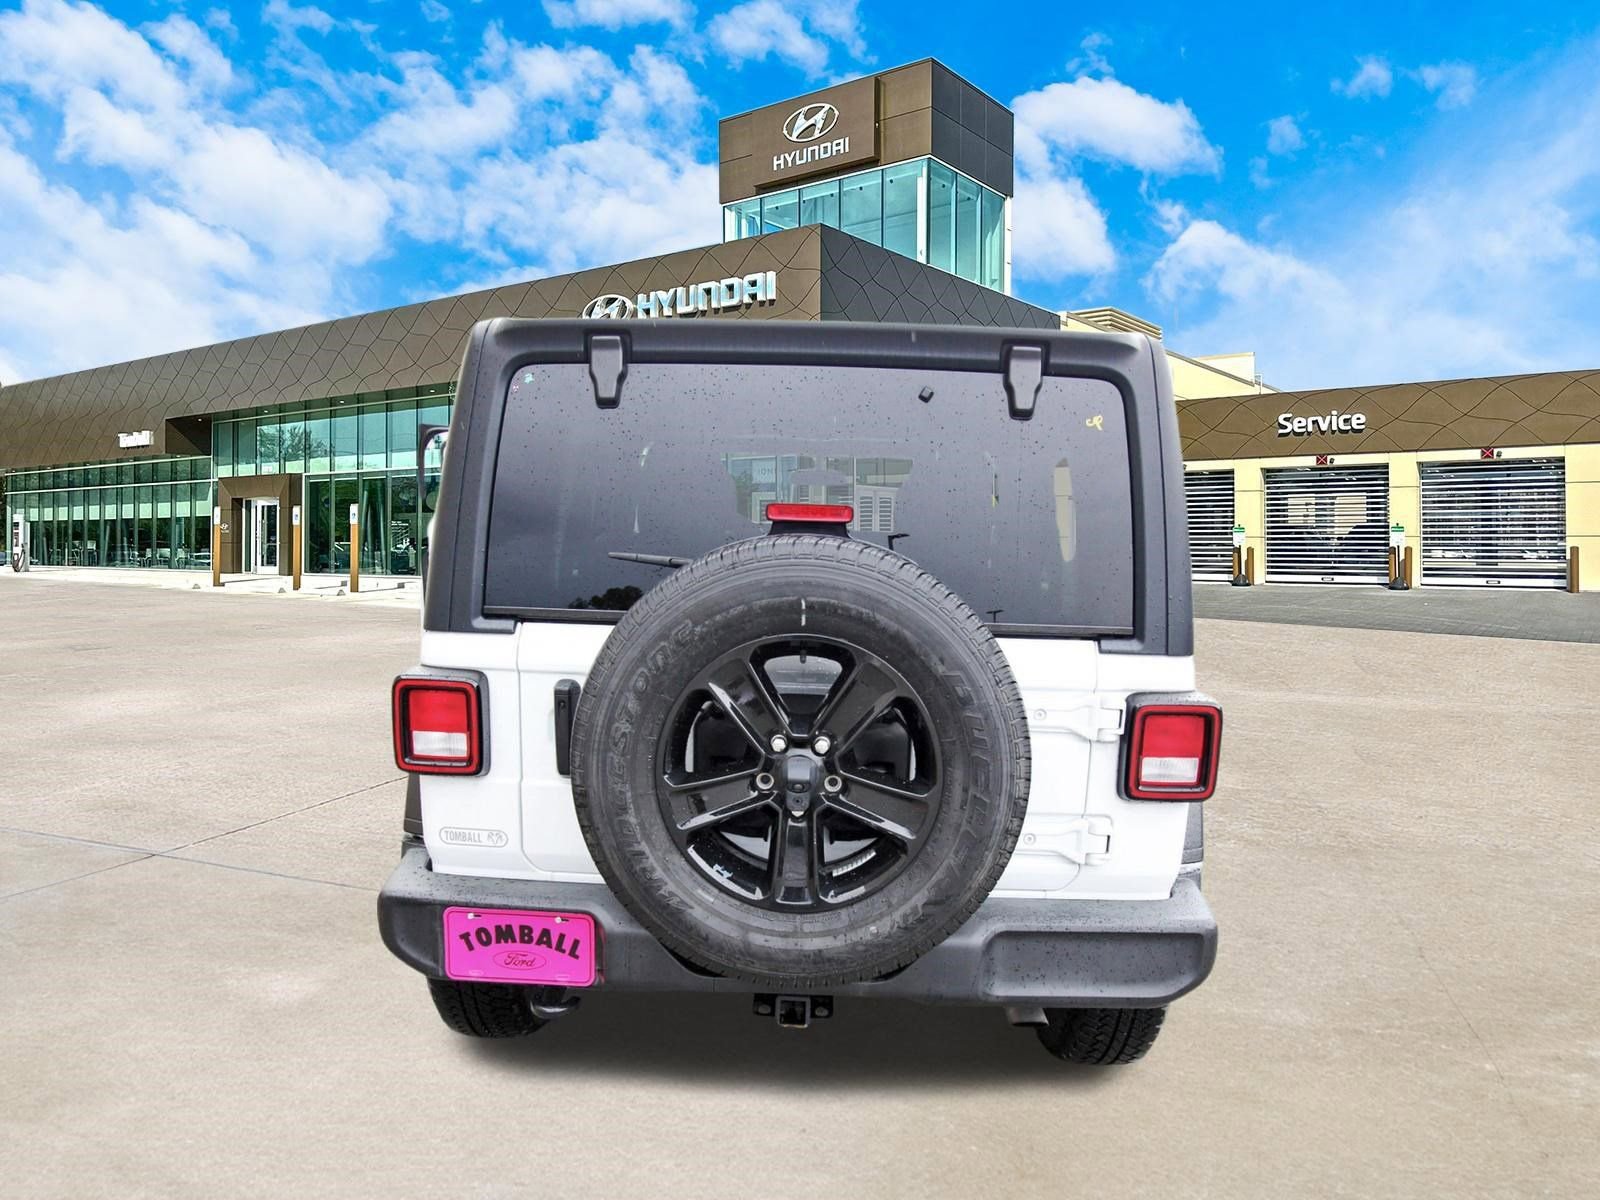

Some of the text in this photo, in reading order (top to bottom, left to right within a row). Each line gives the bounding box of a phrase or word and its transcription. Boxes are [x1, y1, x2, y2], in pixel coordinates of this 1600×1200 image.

[773, 137, 849, 171] HYUNDAI
[636, 271, 777, 318] HYUNDAI
[1278, 410, 1366, 434] Service
[607, 619, 694, 911] BRIDGESTONE
[444, 830, 482, 843] TOMBALL
[459, 924, 580, 960] TOMBALL
[504, 953, 537, 967] Ford
